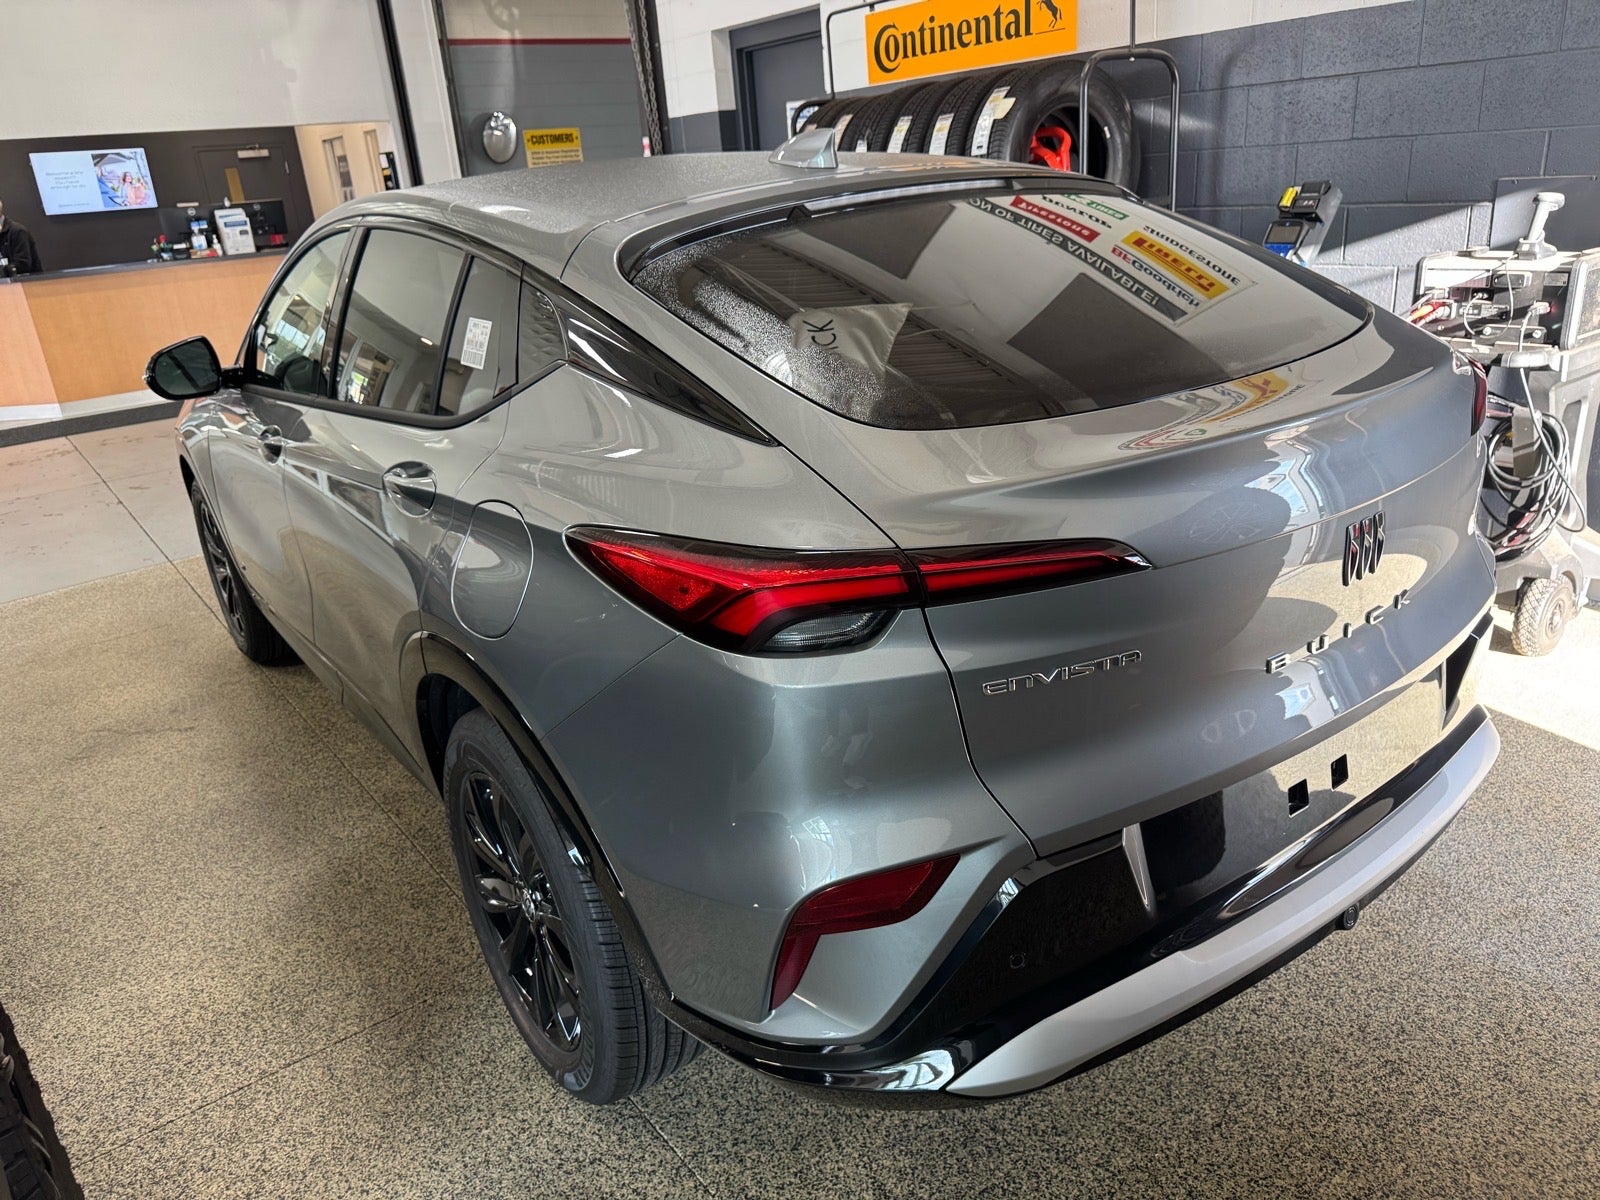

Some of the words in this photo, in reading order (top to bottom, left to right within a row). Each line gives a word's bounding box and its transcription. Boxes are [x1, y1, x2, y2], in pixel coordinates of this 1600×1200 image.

[874, 0, 1033, 73] Continental
[530, 133, 575, 145] CUSTOMERS
[1265, 589, 1411, 674] BUICK
[982, 650, 1142, 695] ENVISTA
